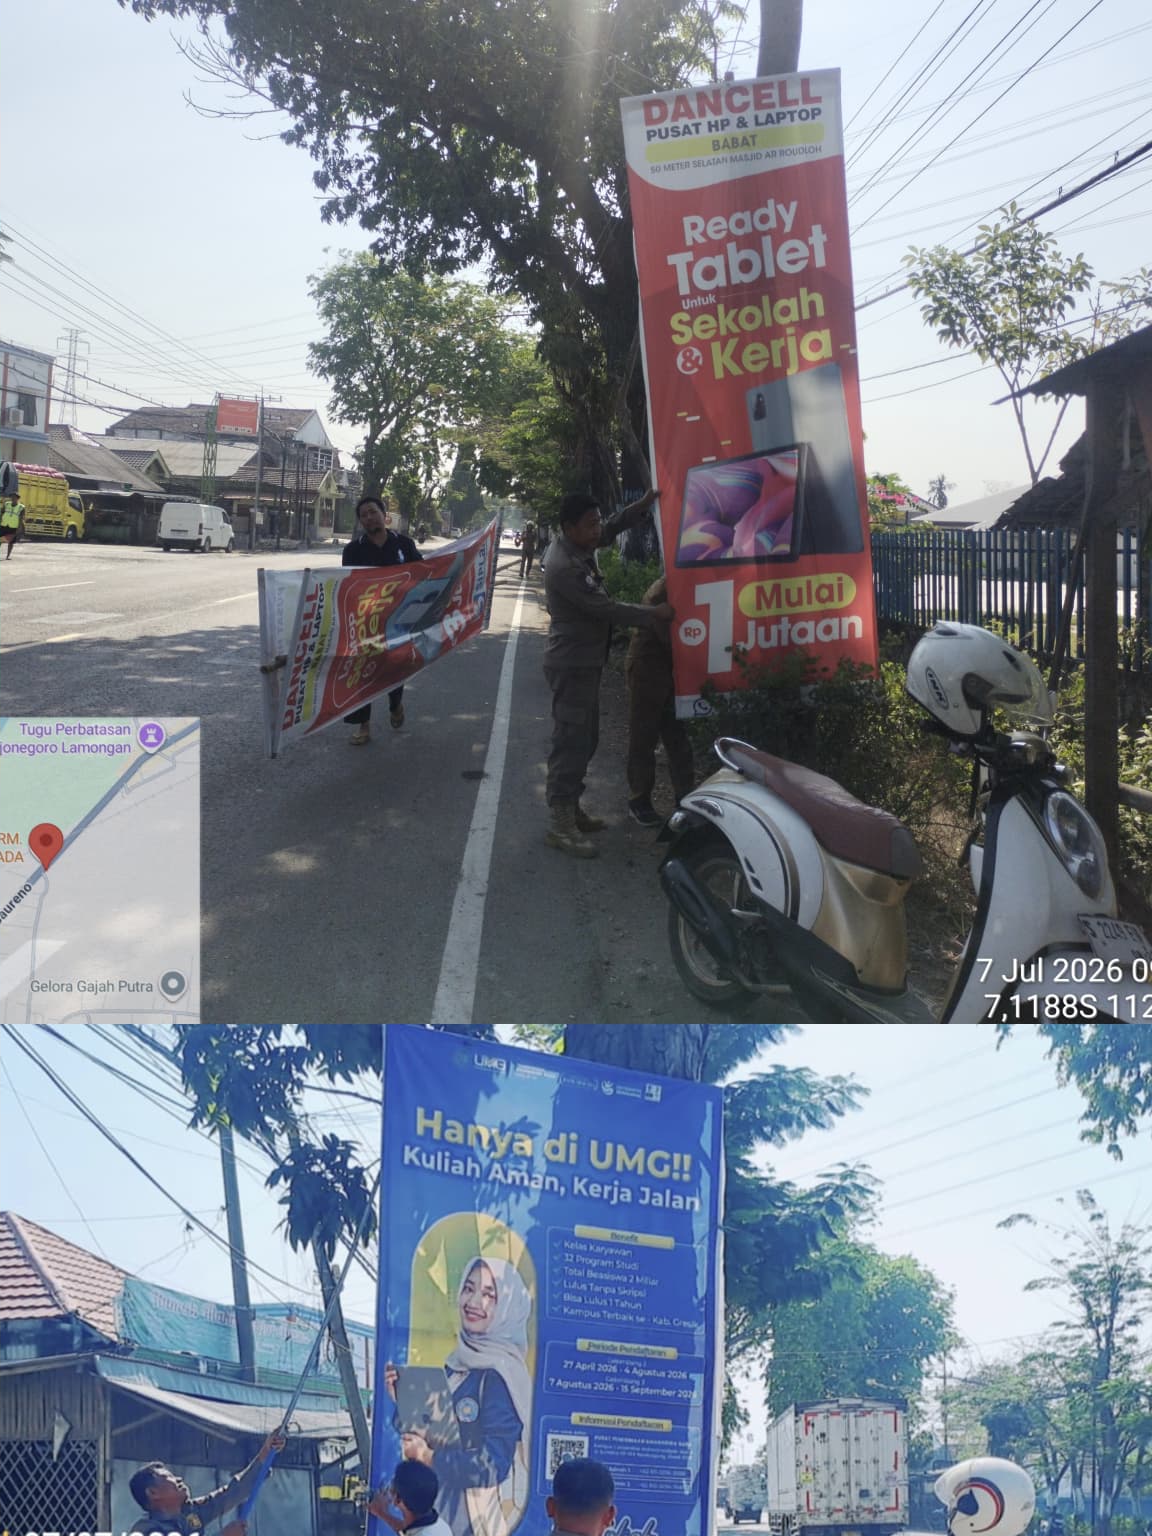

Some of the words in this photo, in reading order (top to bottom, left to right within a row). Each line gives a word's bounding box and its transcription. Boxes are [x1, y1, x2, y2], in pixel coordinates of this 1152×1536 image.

[642, 78, 823, 127] DANCELL
[646, 122, 702, 142] PUSAT
[708, 117, 731, 134] HP
[737, 116, 749, 129] &
[754, 107, 823, 127] LAPTOP
[711, 134, 758, 152] BABAT
[650, 165, 662, 175] 50
[664, 160, 691, 173] METER
[692, 156, 729, 169] SELATAN
[730, 151, 763, 164] MASJID
[764, 149, 778, 159] AR
[682, 198, 798, 246] Ready
[667, 224, 828, 296] Tablet
[670, 287, 825, 346] Sekolah
[682, 293, 717, 310] Untuk
[711, 328, 833, 380] Kerja
[755, 576, 845, 612] Mulai
[684, 624, 701, 641] Rp
[695, 580, 735, 675] 1
[735, 615, 864, 650] Jutaan
[282, 583, 320, 732] DANCELL
[416, 1107, 533, 1159] Hanya
[544, 1132, 578, 1165] di
[590, 1142, 692, 1182] UMG!!
[403, 1145, 481, 1179] Kuliah
[488, 1162, 566, 1197] Aman,
[573, 1176, 632, 1205] Kerja
[639, 1187, 699, 1212] Jalan
[564, 1241, 588, 1252] Kelas
[589, 1243, 633, 1257] Karyawan
[575, 1255, 614, 1269] Program
[615, 1260, 639, 1271] Studi
[564, 1267, 585, 1277] Total
[564, 1281, 587, 1291] Lulus
[589, 1283, 616, 1295] Tanpa
[564, 1306, 602, 1319] Kampus
[614, 1298, 642, 1310] Tahun
[555, 1378, 593, 1391] Agustus
[575, 1360, 595, 1372] April
[632, 1367, 666, 1380] Agustus
